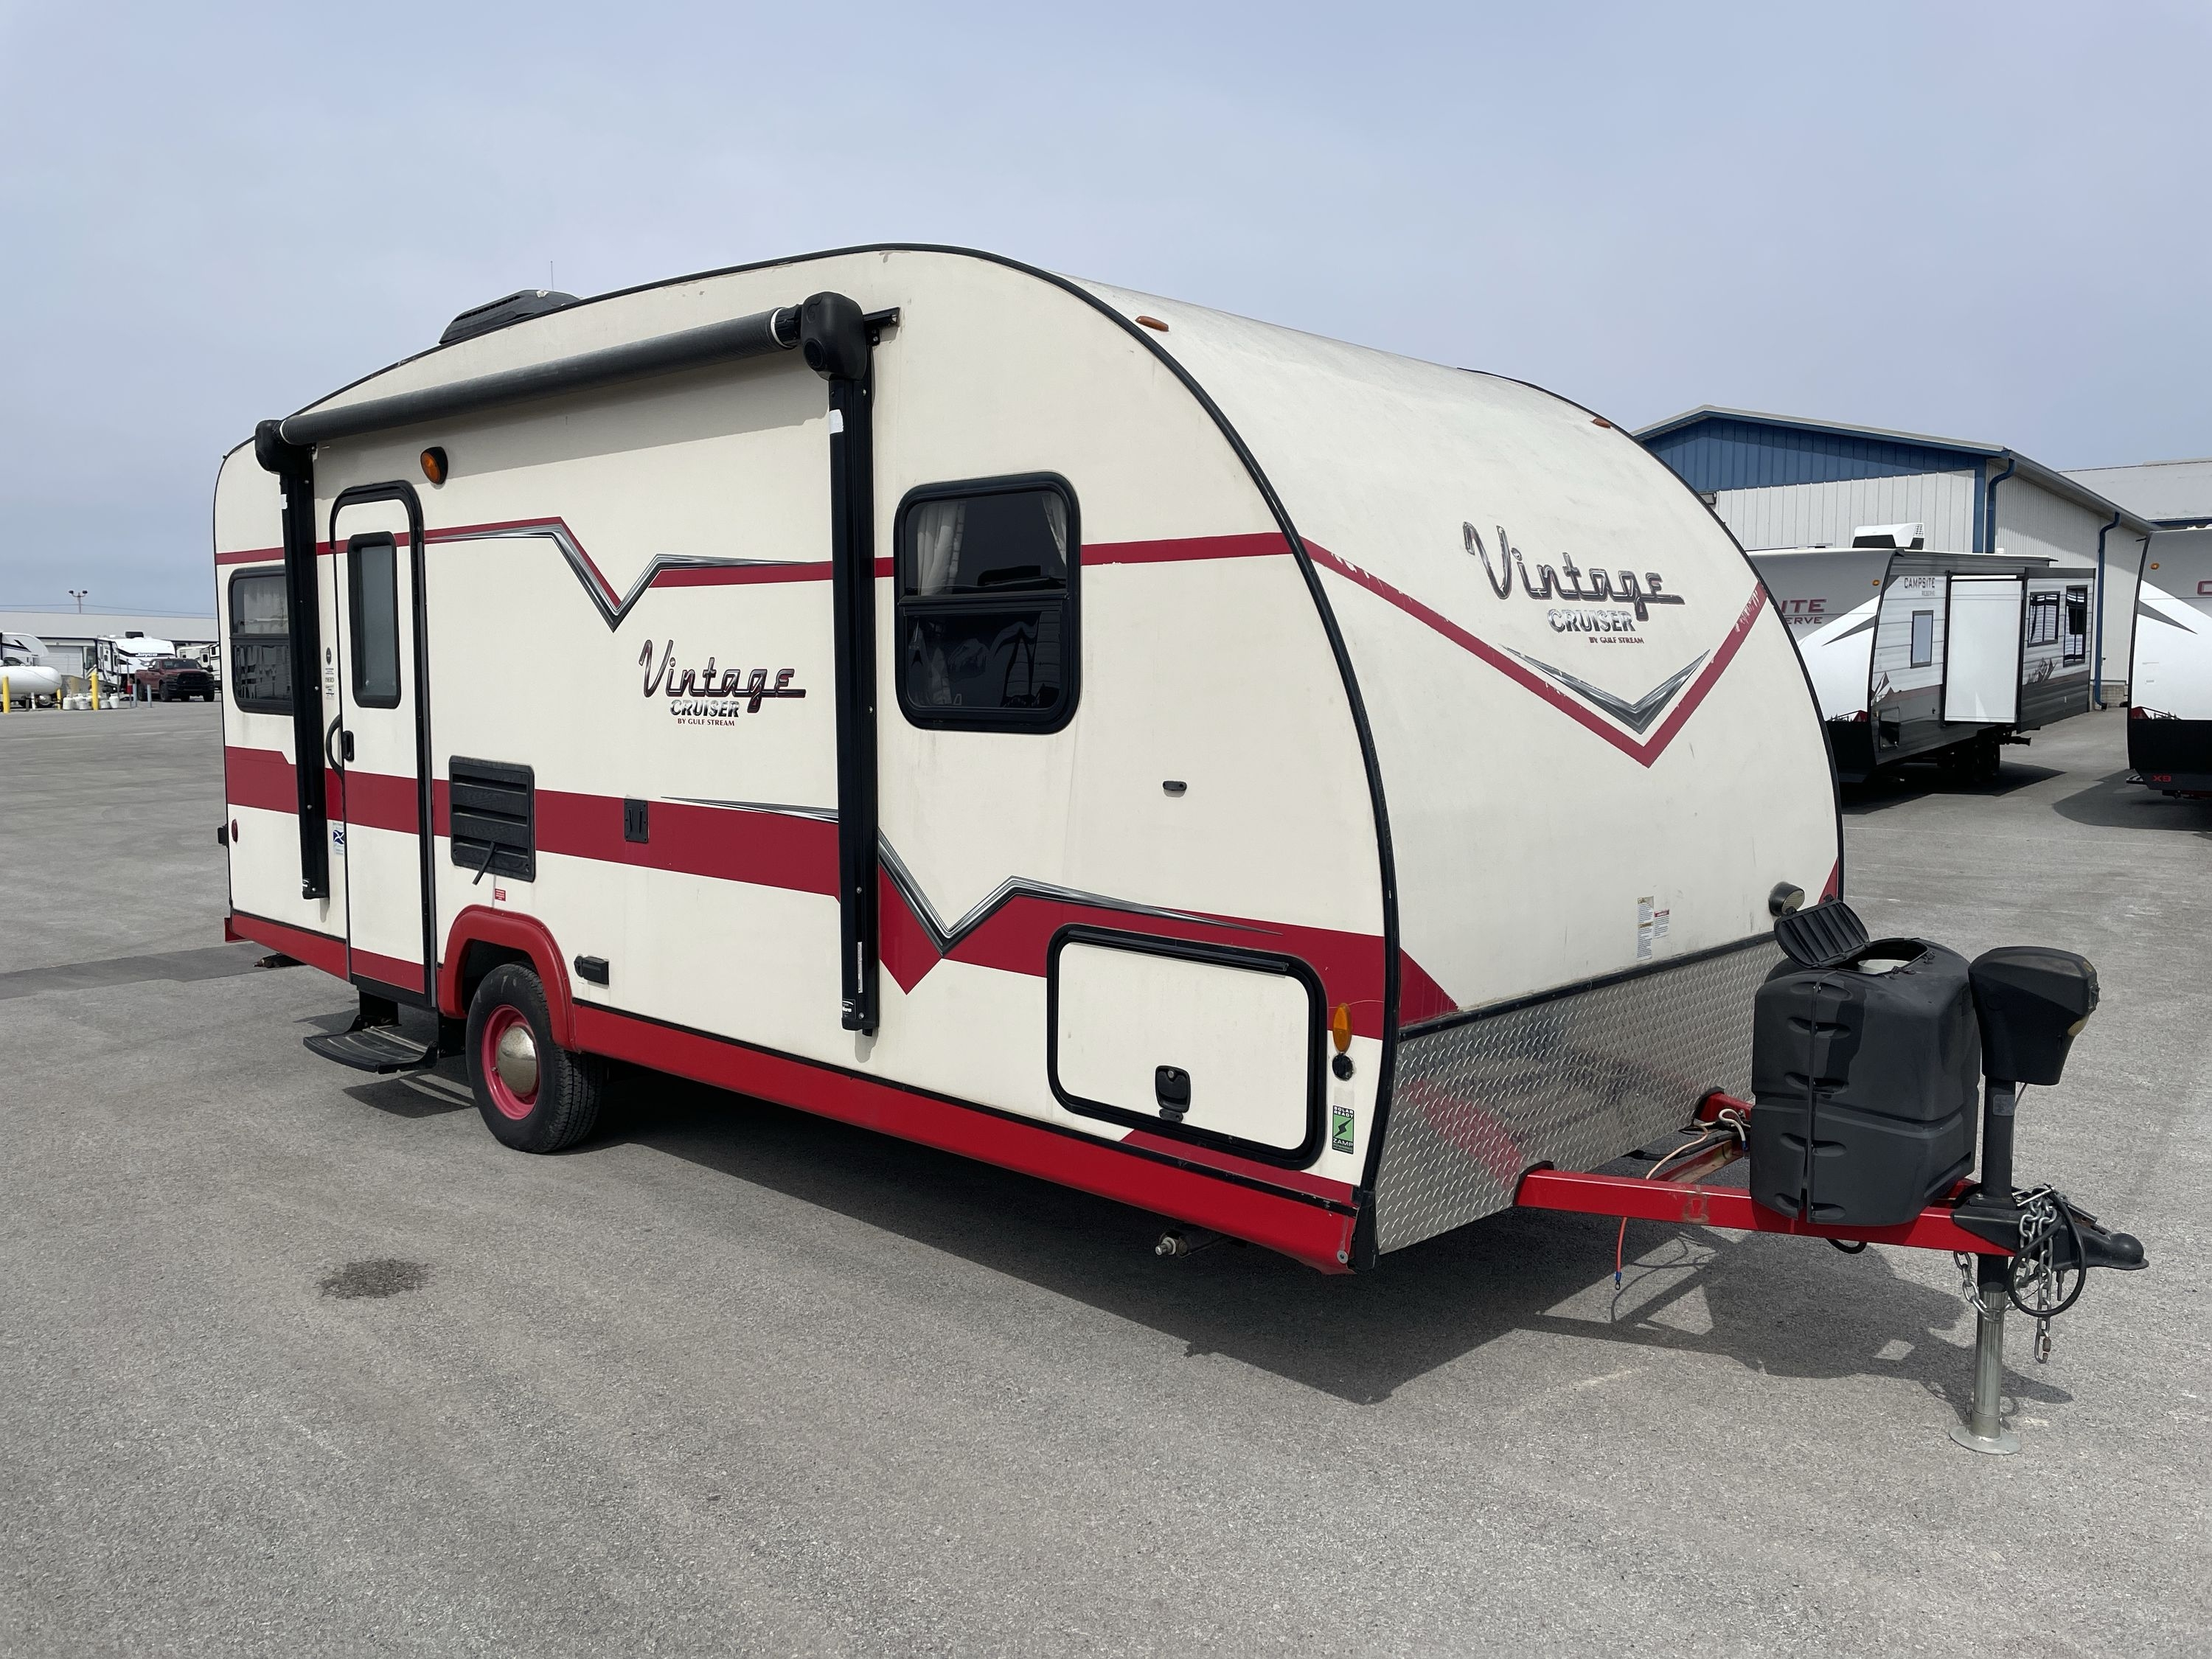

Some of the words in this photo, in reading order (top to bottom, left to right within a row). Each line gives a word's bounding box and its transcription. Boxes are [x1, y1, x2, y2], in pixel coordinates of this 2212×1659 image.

[1462, 521, 1686, 622] Vintage
[1904, 577, 1935, 589] CAMPSITE
[1781, 599, 1827, 613] ITE
[1547, 608, 1636, 633] CRUISER
[1785, 616, 1823, 625] ERVE
[638, 639, 807, 714] Vintage
[669, 699, 740, 717] CRUISER
[1334, 1106, 1354, 1114] SOLAR
[1334, 1110, 1354, 1119] READY
[1333, 1138, 1354, 1147] ZAMP
